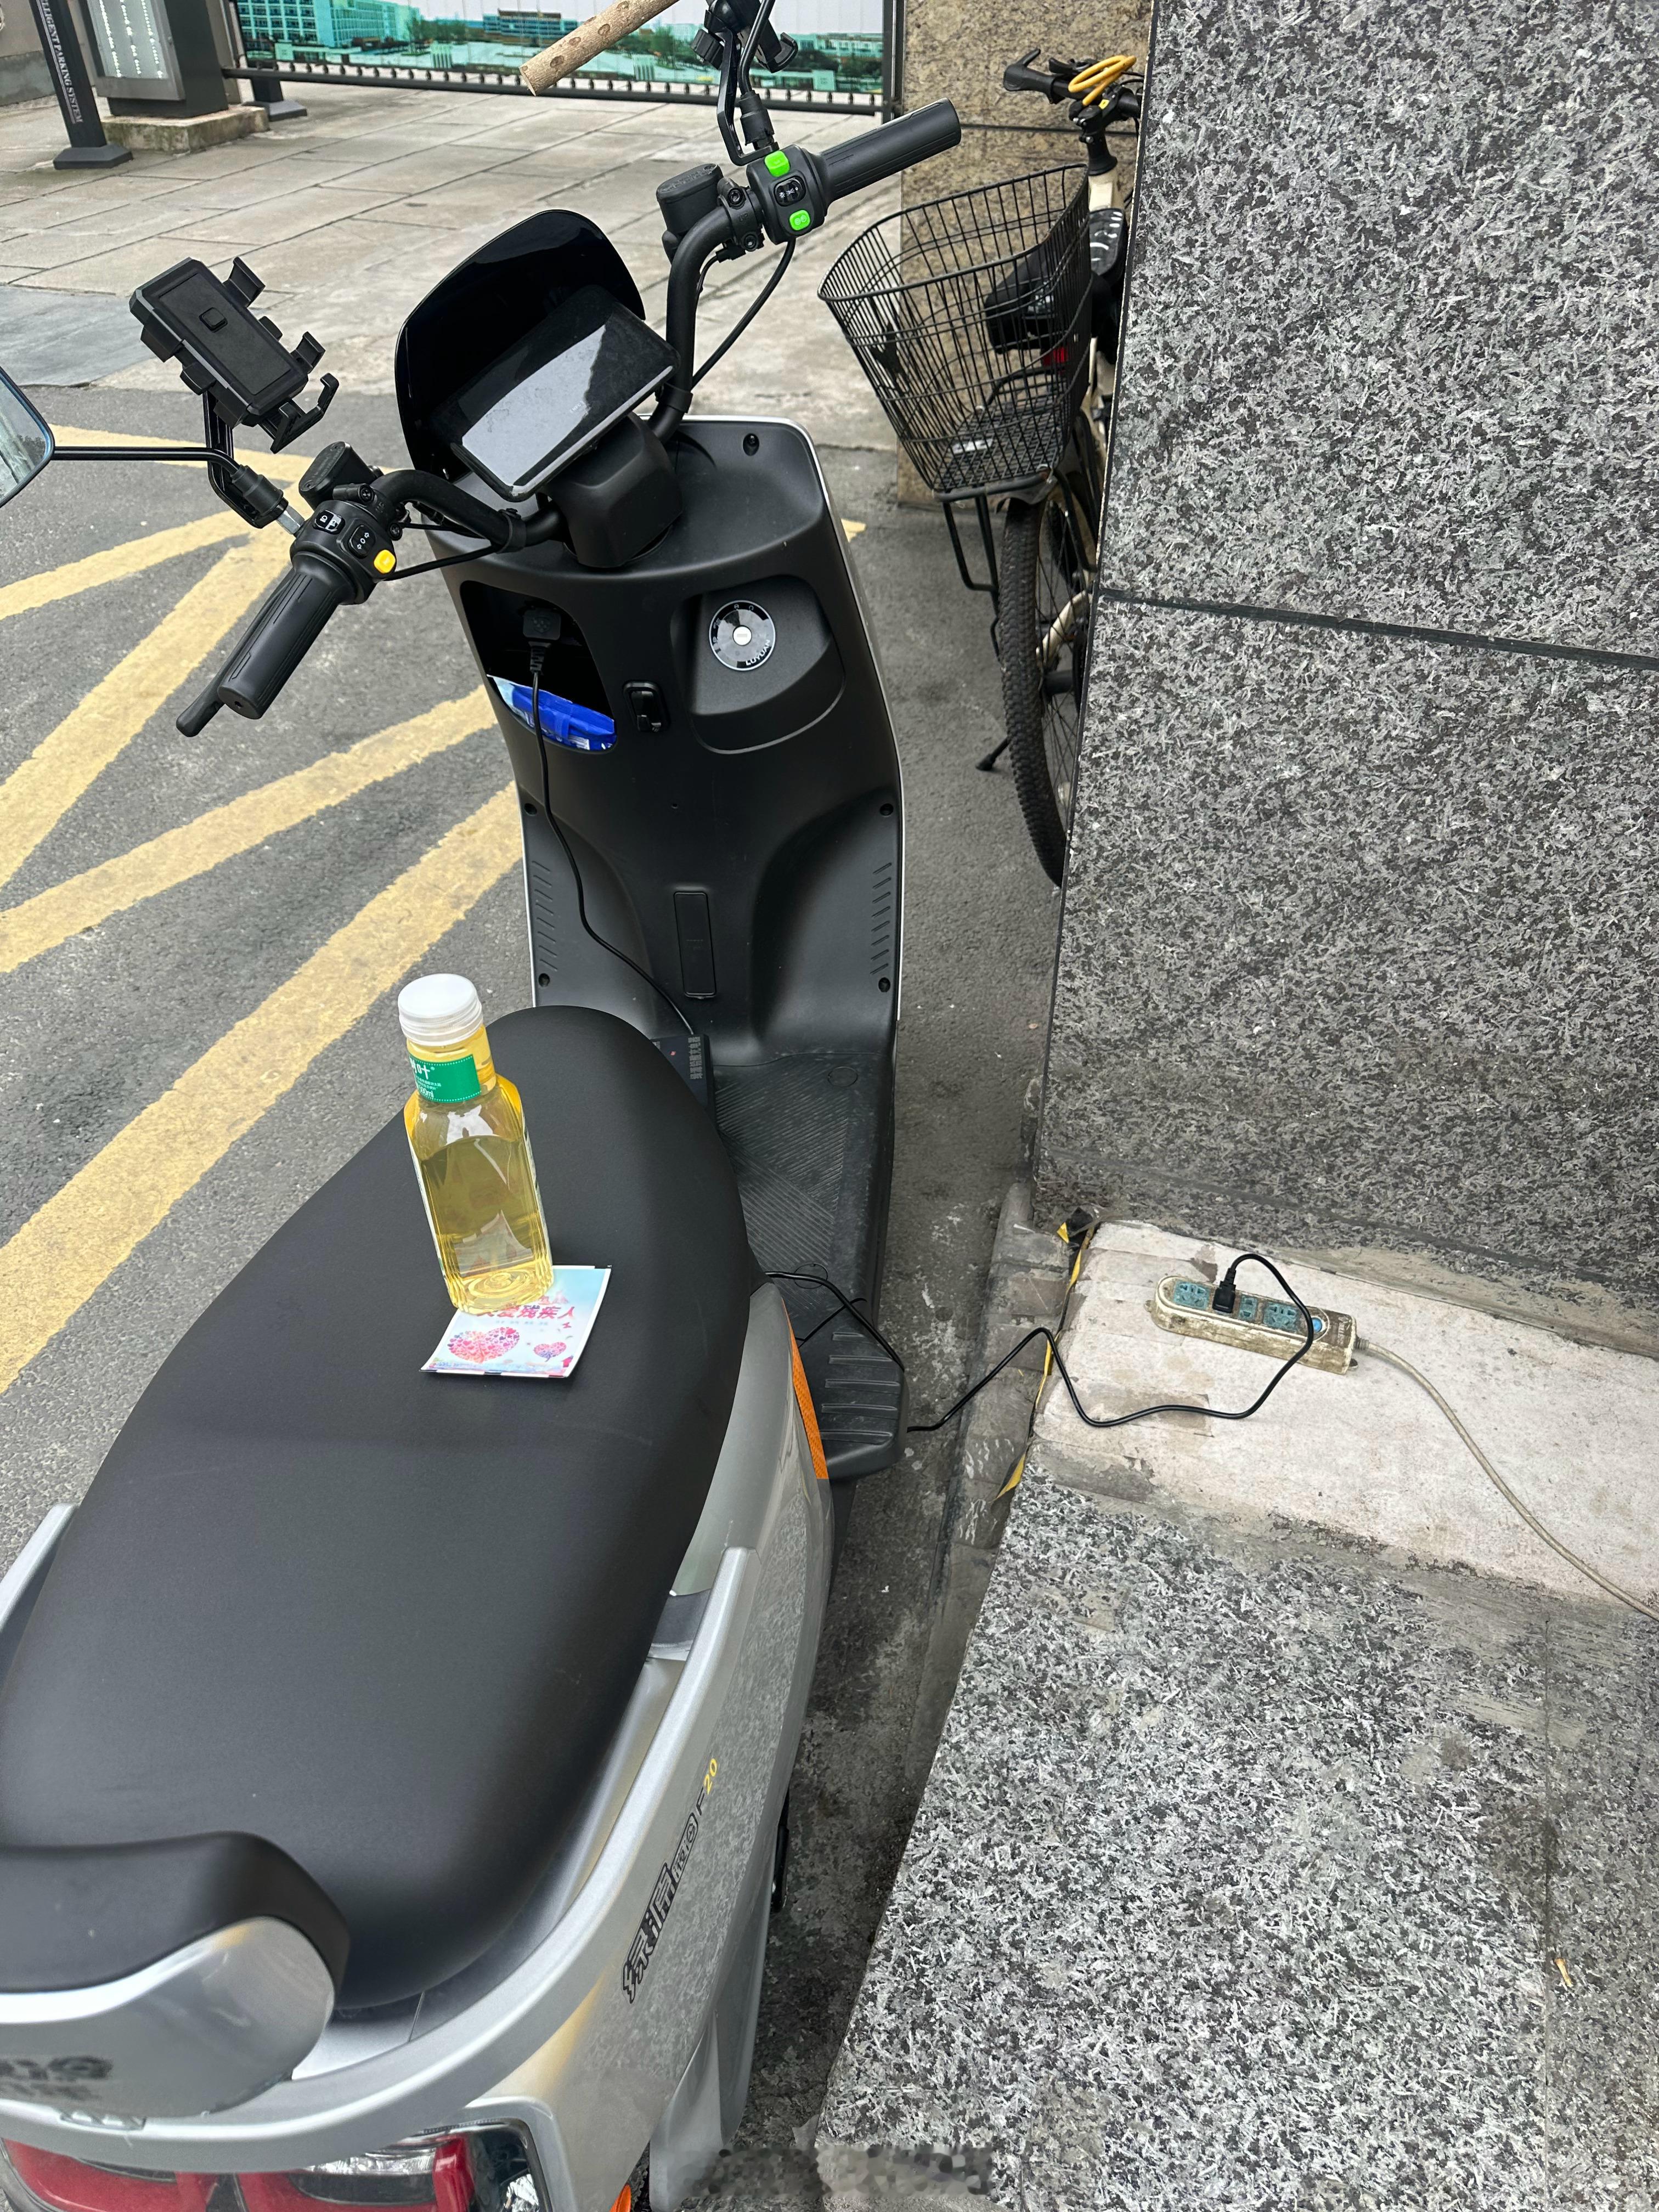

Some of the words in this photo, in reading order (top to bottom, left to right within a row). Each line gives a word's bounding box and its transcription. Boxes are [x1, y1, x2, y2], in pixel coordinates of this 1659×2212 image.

[54, 44, 72, 86] PARKING
[66, 87, 83, 122] SYSTEM
[746, 639, 770, 666] LUYUAN
[622, 1863, 678, 2004] 绿源
[696, 1758, 718, 1816] F20
